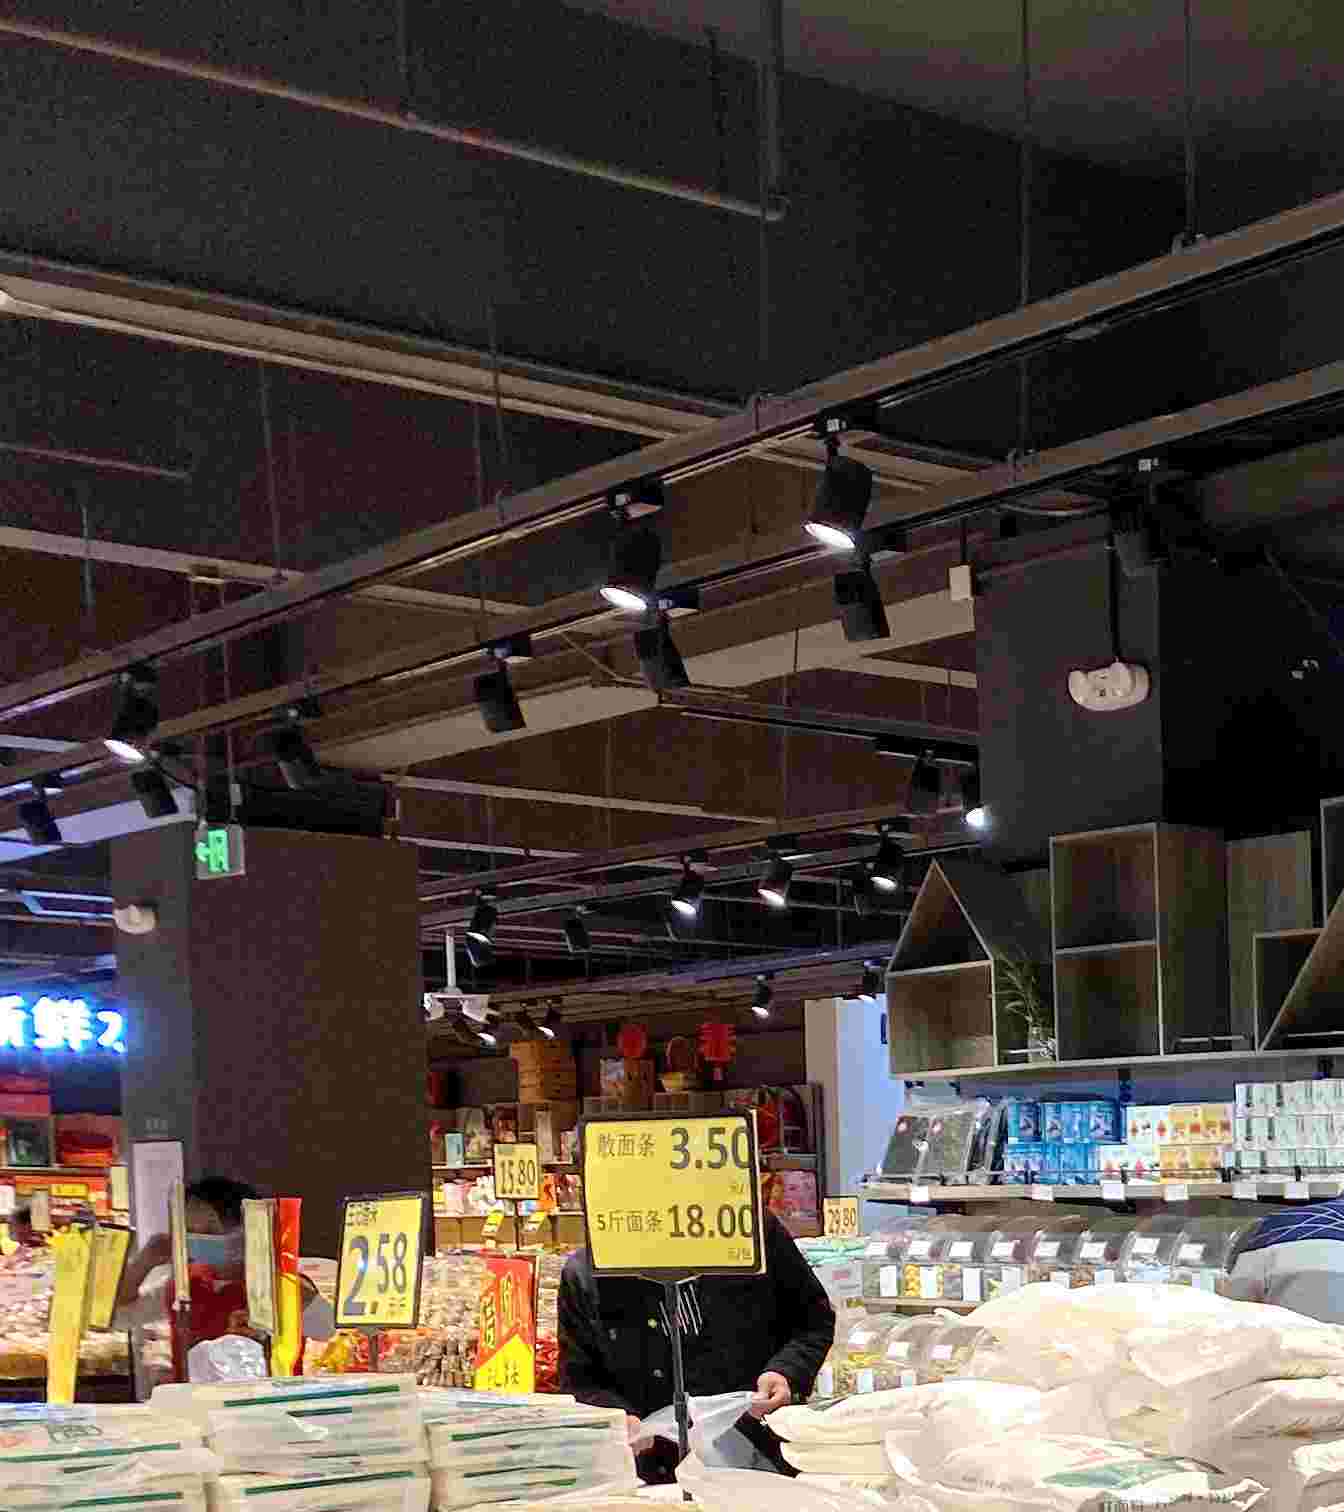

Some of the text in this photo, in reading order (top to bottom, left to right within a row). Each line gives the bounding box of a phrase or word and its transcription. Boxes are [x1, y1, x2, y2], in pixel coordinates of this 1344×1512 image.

[669, 1126, 752, 1171] 3.50
[668, 1204, 753, 1239] 18.00
[342, 1231, 409, 1318] 2.58
